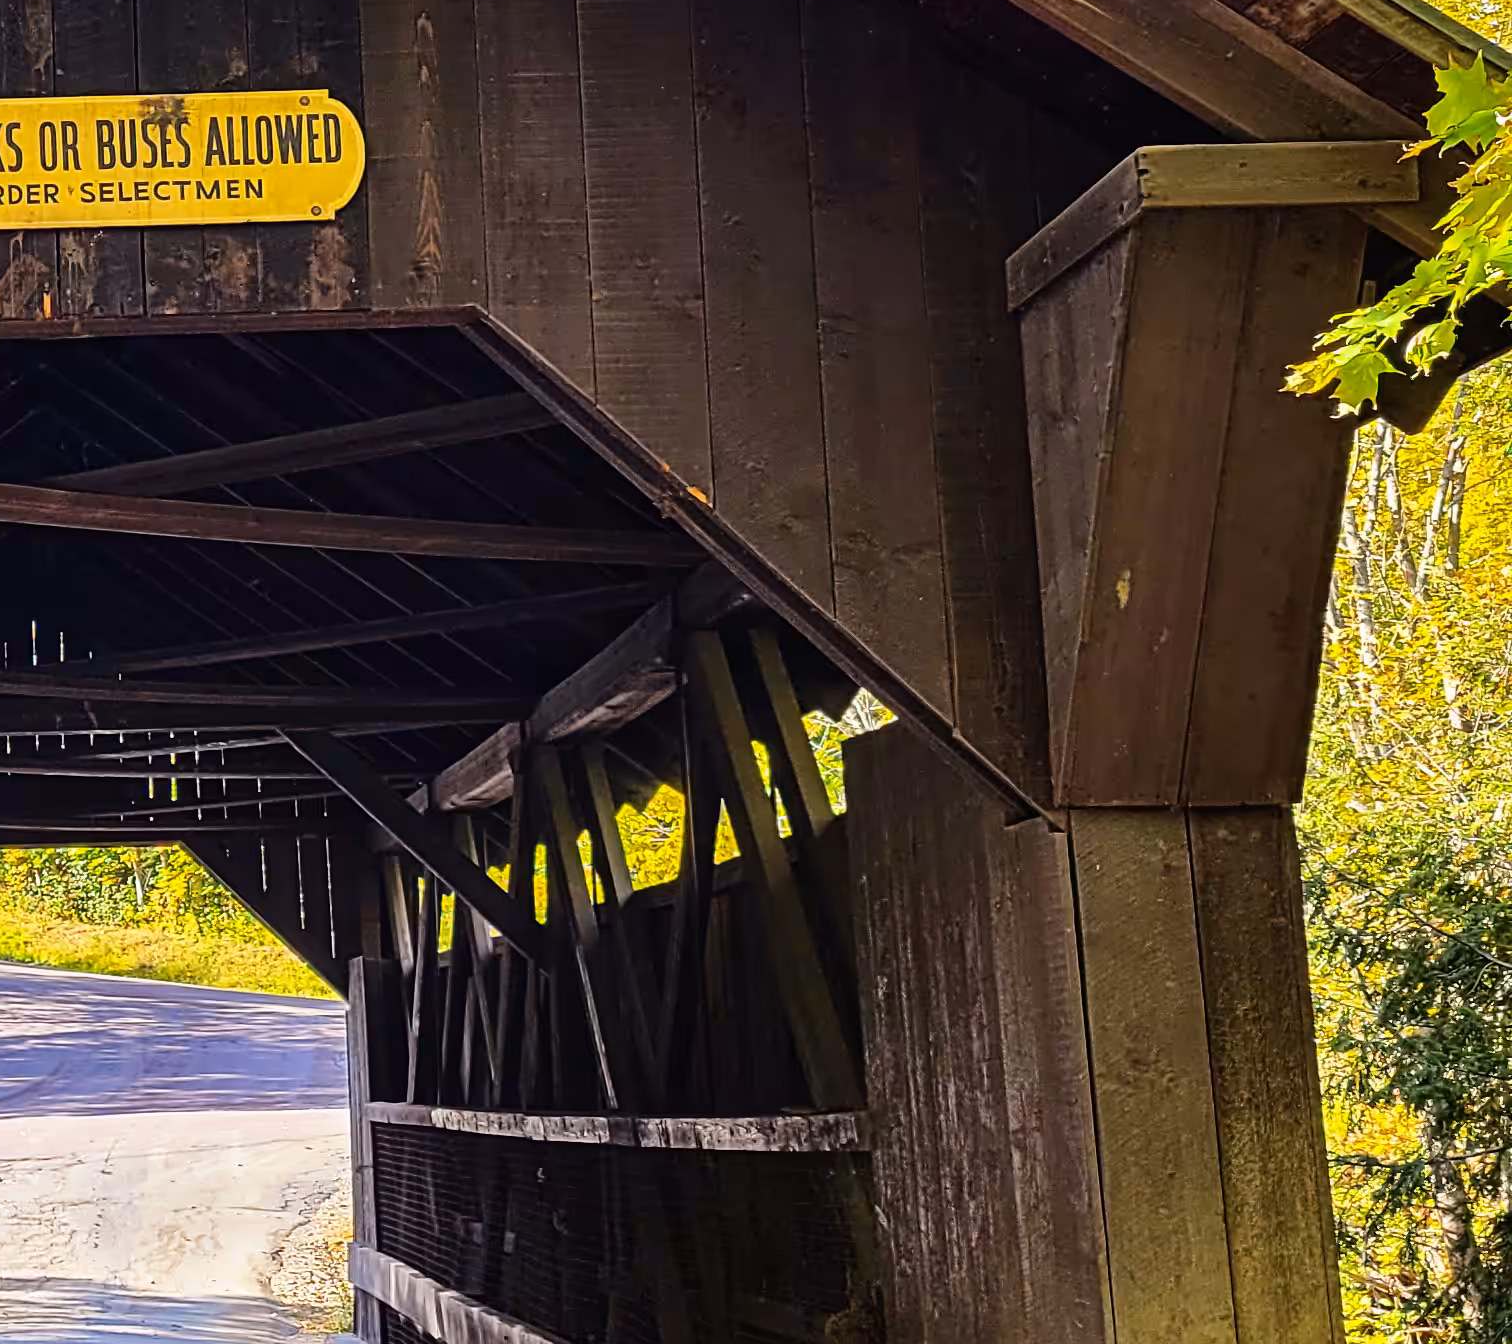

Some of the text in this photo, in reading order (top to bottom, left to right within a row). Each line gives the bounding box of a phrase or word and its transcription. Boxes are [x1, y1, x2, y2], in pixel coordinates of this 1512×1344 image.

[38, 120, 80, 172] OR
[96, 115, 192, 170] BUSES
[205, 113, 343, 167] ALLOWED
[79, 178, 264, 204] SELECTMEN
